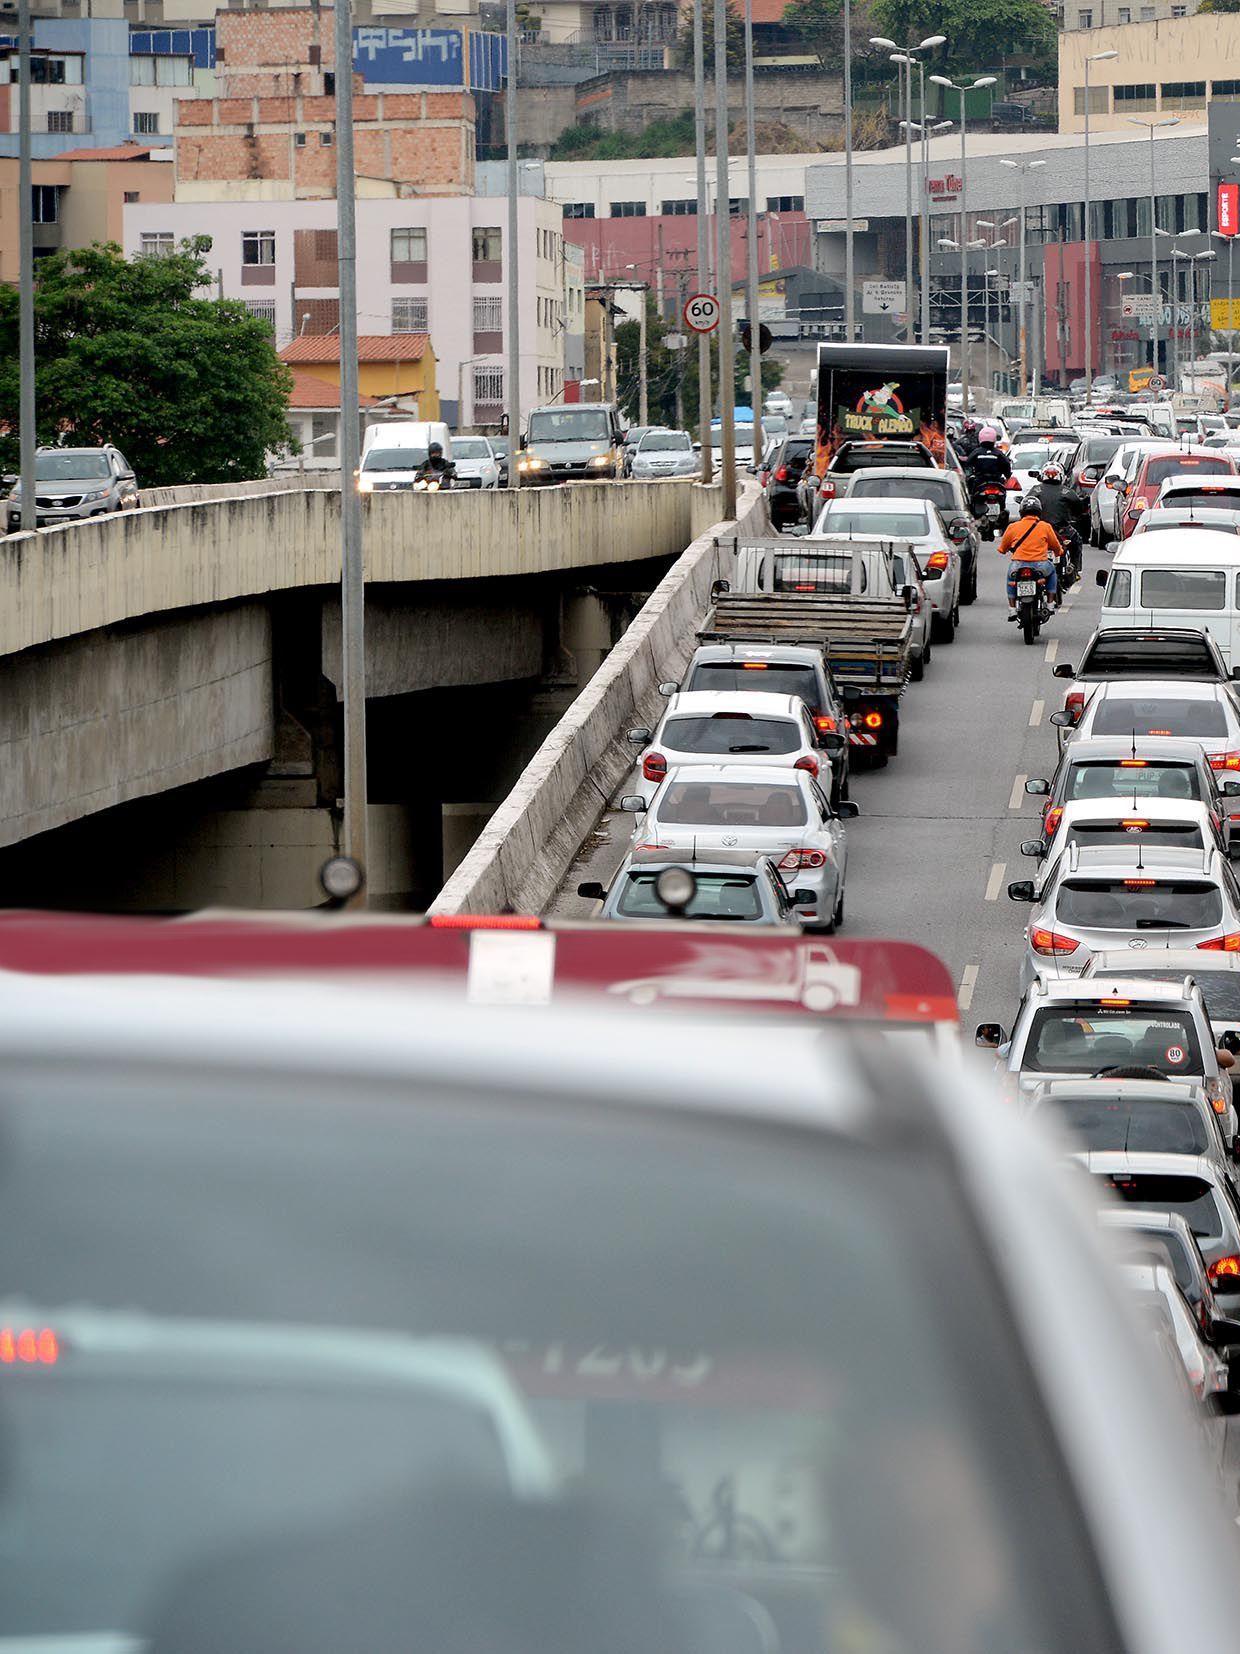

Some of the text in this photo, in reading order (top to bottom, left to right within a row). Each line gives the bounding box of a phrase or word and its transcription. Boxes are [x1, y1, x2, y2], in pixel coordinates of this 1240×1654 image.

[691, 302, 714, 317] 60
[845, 414, 873, 431] TRUCK
[1169, 1049, 1181, 1058] 80
